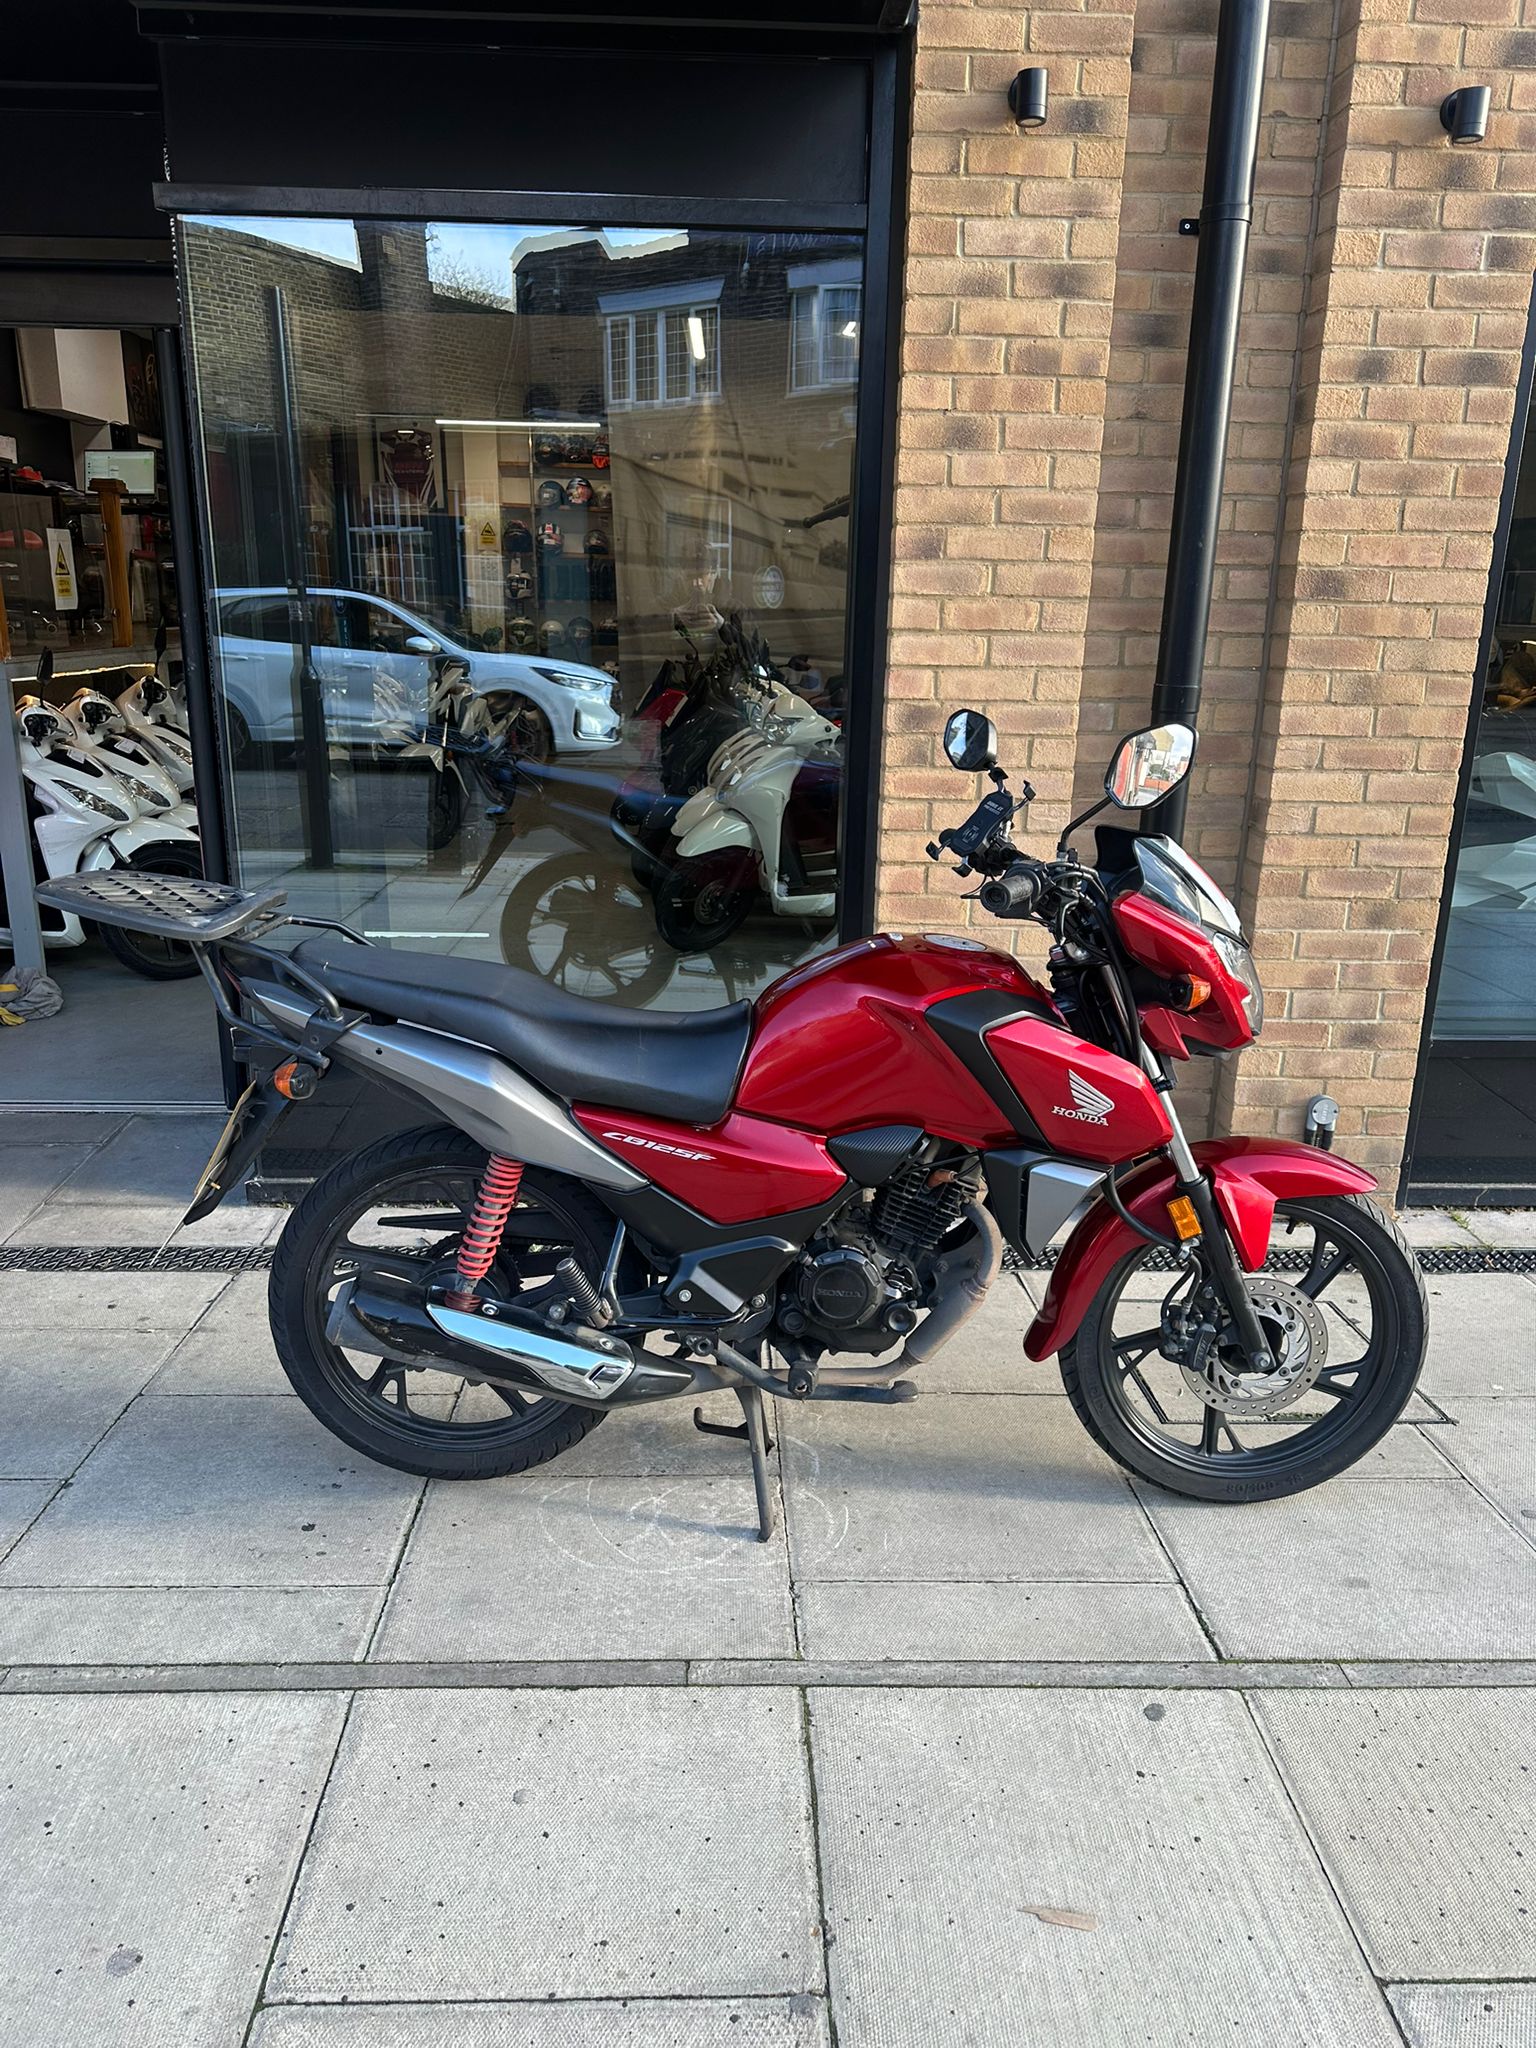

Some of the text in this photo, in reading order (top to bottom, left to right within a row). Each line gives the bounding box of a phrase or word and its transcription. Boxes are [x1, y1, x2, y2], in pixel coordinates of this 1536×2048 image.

[1051, 1105, 1109, 1127] HONDA
[602, 1131, 717, 1160] CB125F
[816, 1287, 864, 1298] HONDA
